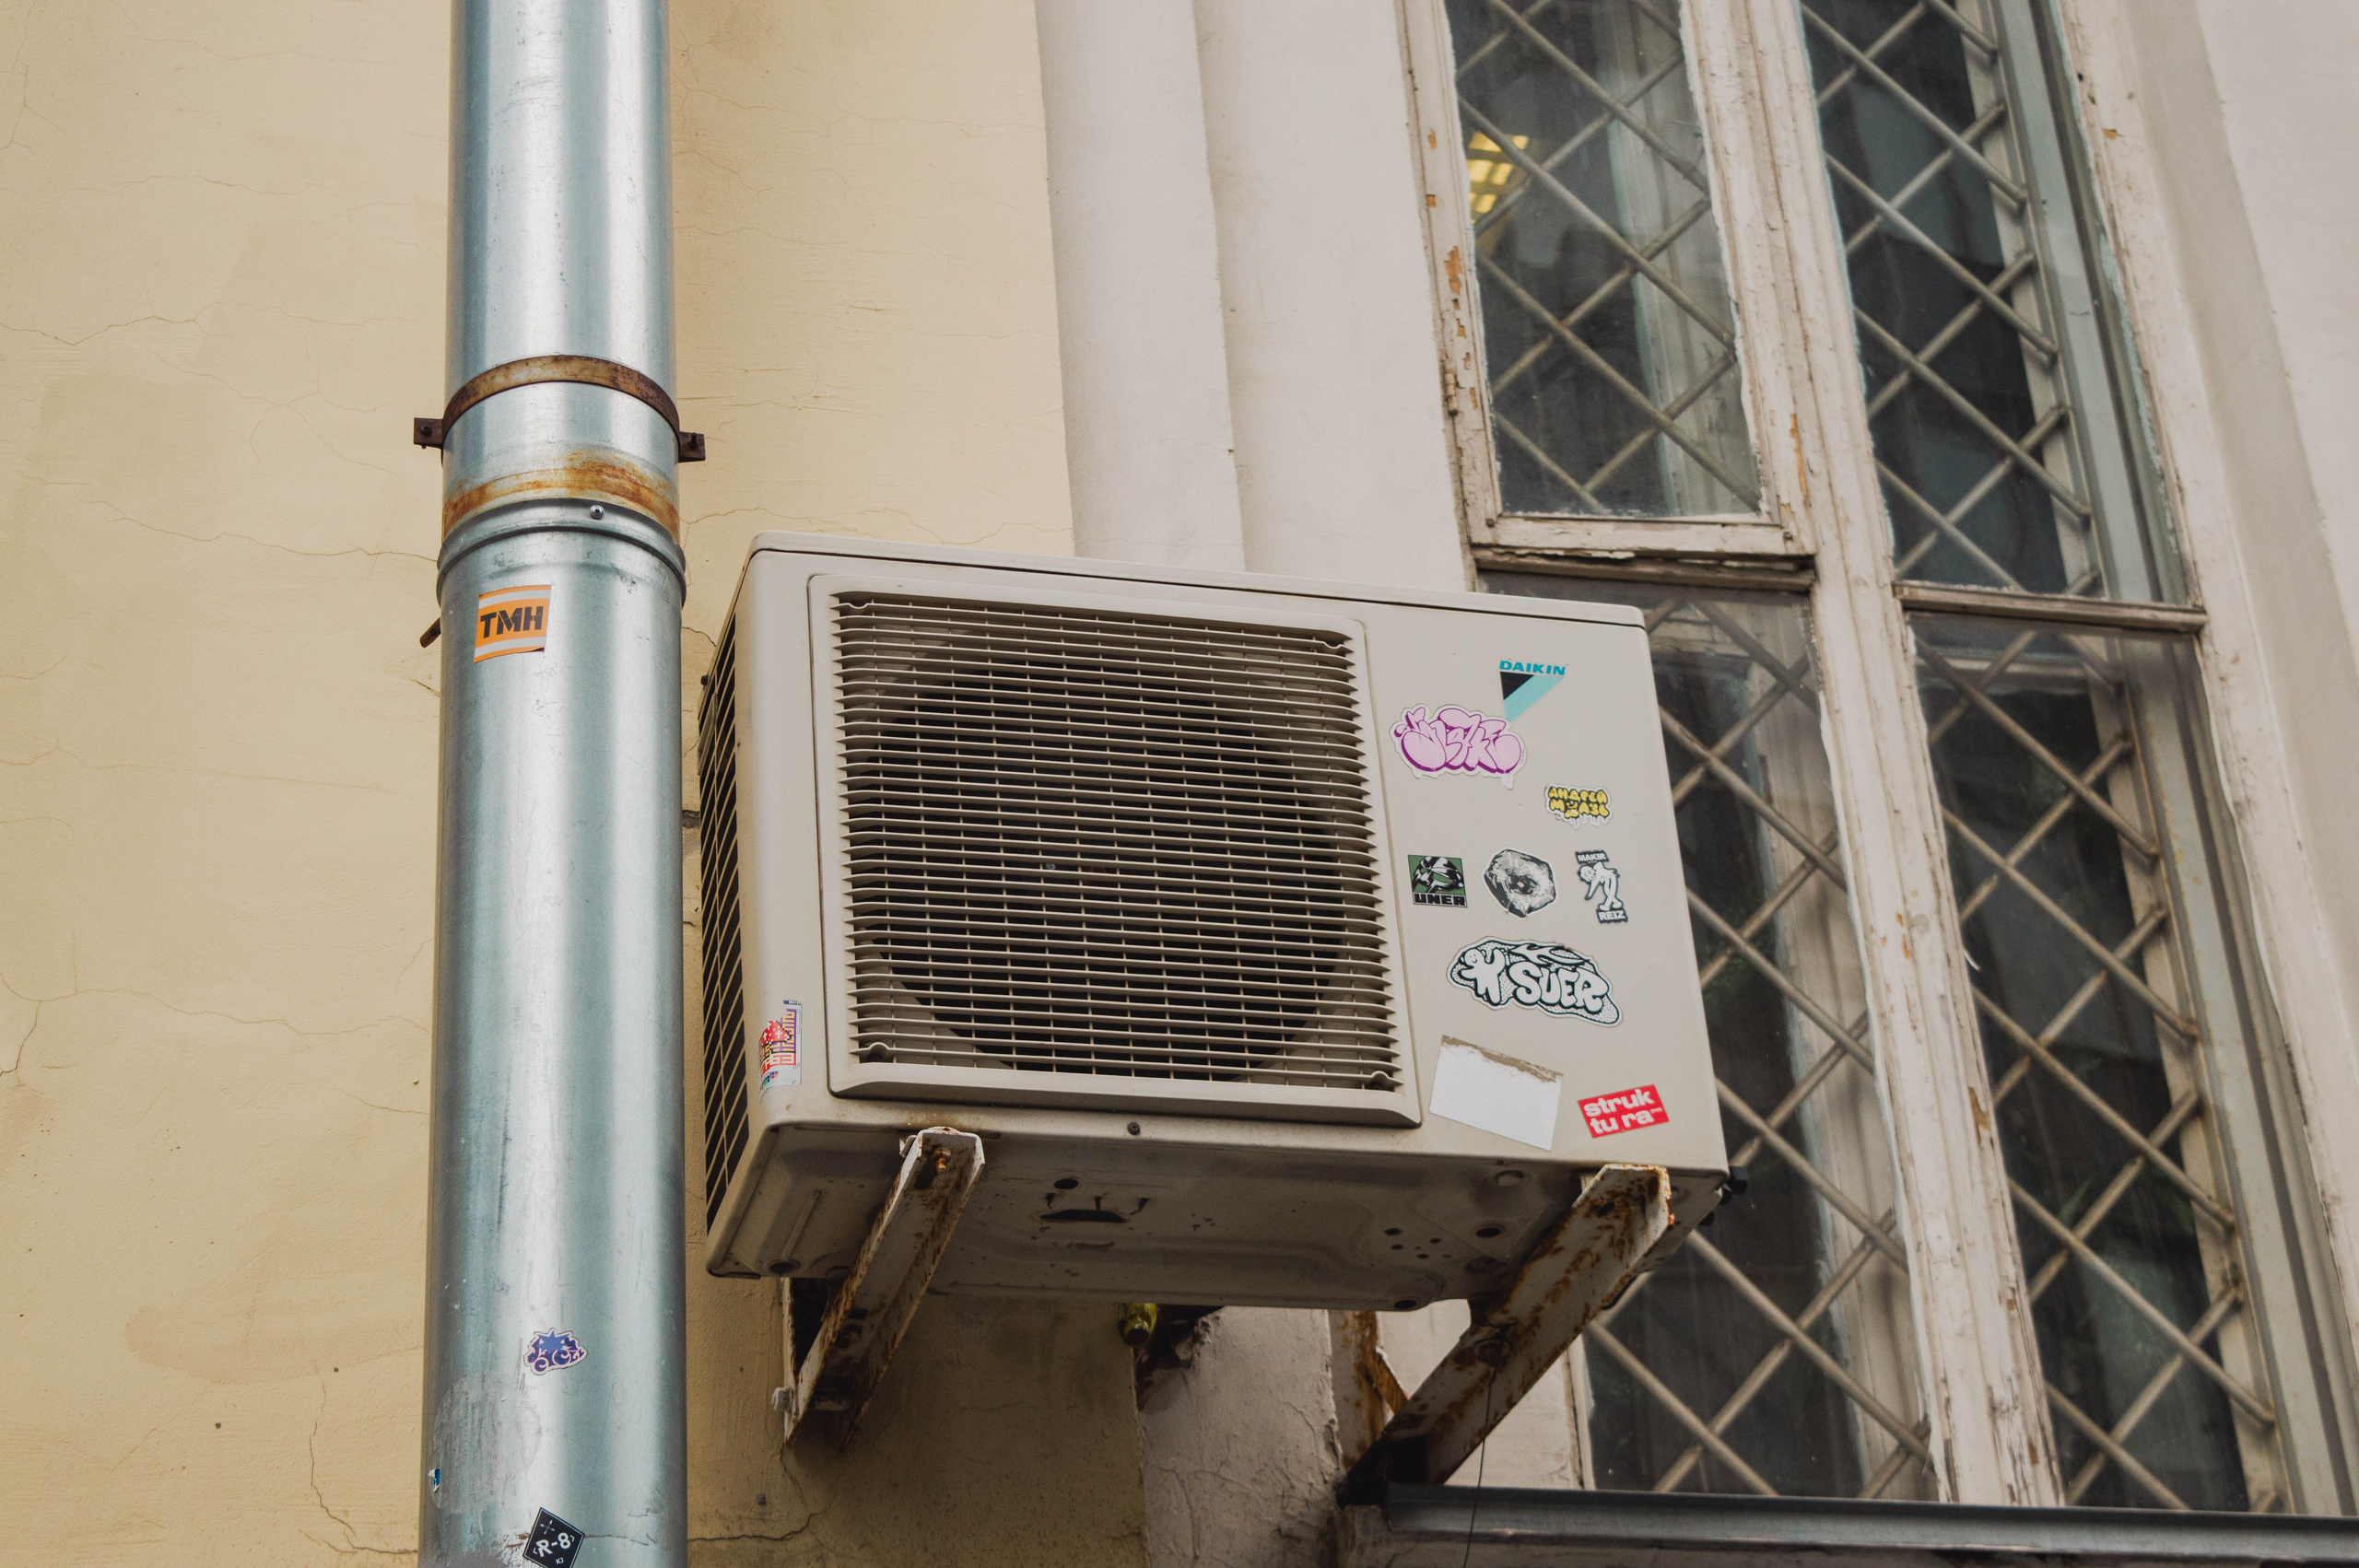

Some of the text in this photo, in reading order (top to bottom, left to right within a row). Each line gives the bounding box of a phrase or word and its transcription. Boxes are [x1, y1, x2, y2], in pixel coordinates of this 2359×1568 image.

[480, 606, 544, 638] TMH
[1499, 661, 1566, 675] DAIKIN
[1414, 894, 1465, 906] UNER
[1598, 910, 1625, 920] REIZ
[1583, 1089, 1655, 1117] struk
